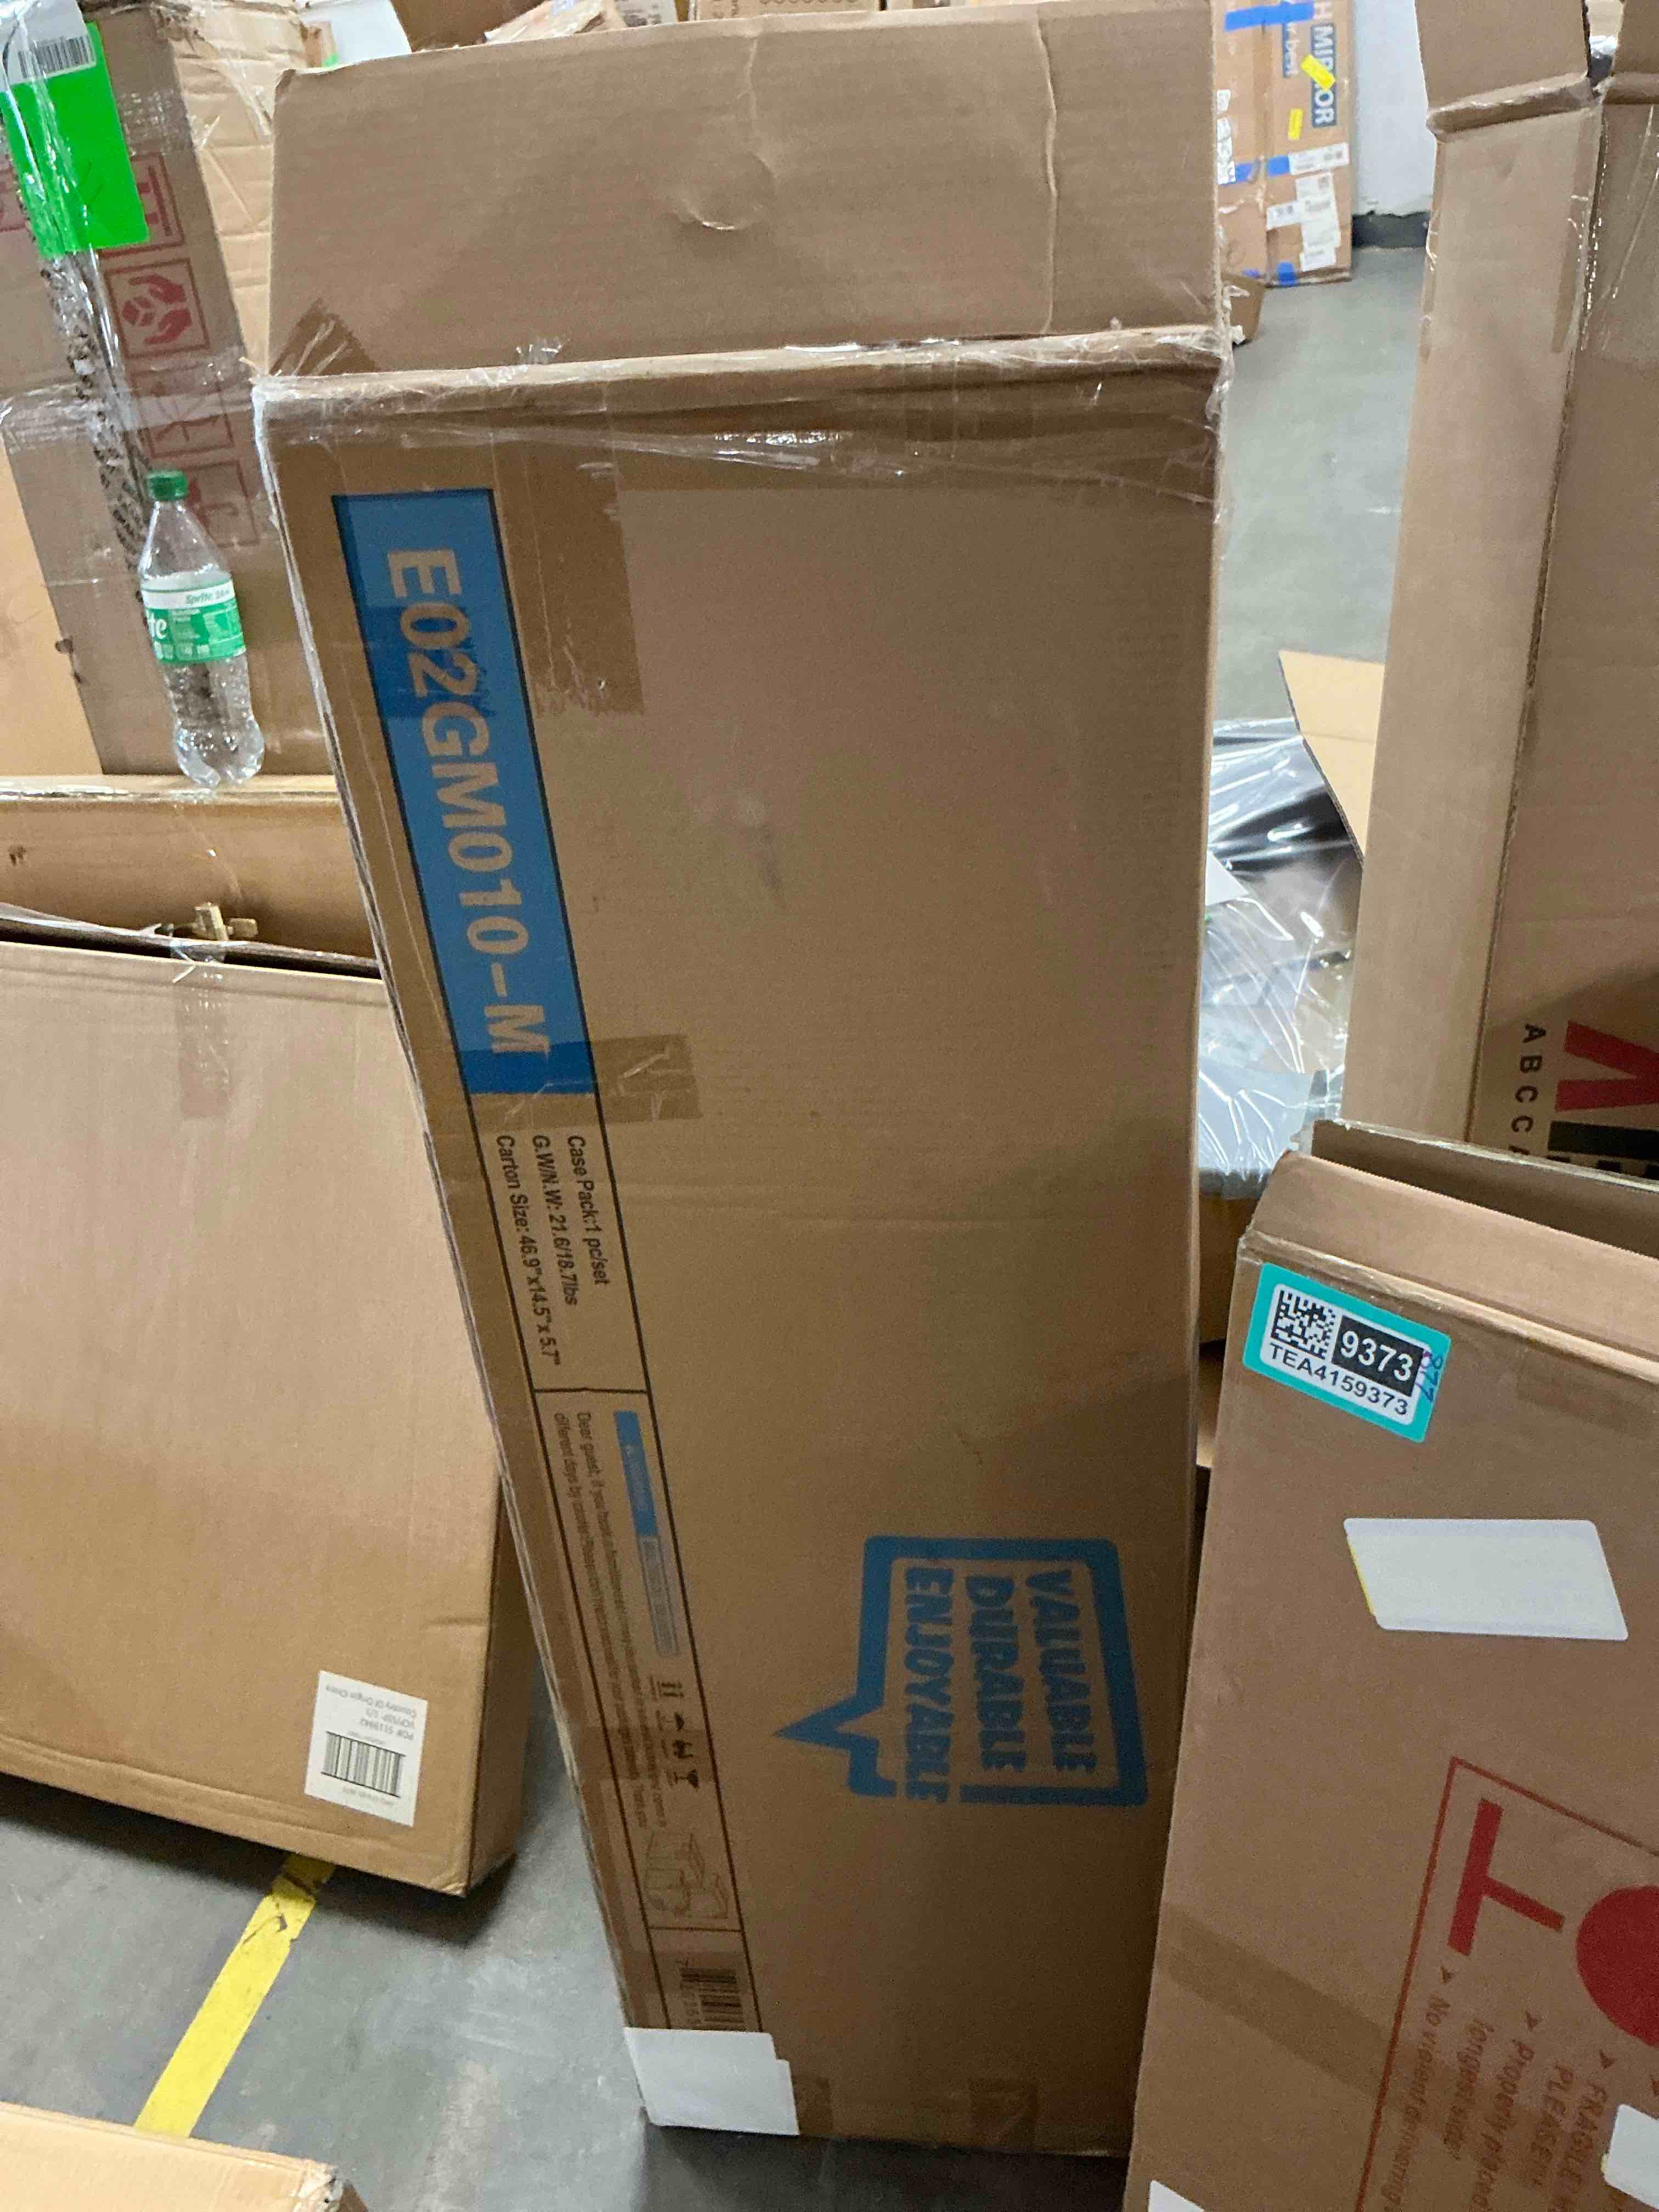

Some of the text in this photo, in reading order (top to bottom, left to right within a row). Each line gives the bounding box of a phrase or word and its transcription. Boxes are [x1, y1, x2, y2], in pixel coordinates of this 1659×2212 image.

[1313, 26, 1334, 125] MIROR
[387, 548, 551, 1056] E02GM010-M
[496, 1135, 521, 1189] Carton
[510, 1194, 530, 1232] Size:
[567, 1136, 588, 1175] Case
[582, 1238, 610, 1285] pc/set
[549, 1214, 578, 1306] 21.6/18.7lbs
[1270, 1342, 1408, 1415] TEA4159373
[1340, 1330, 1413, 1382] 9373
[904, 1566, 955, 1804] ENJOYABLE
[966, 1574, 1026, 1772] DURABLE
[1026, 1570, 1097, 1774] VALUABLE
